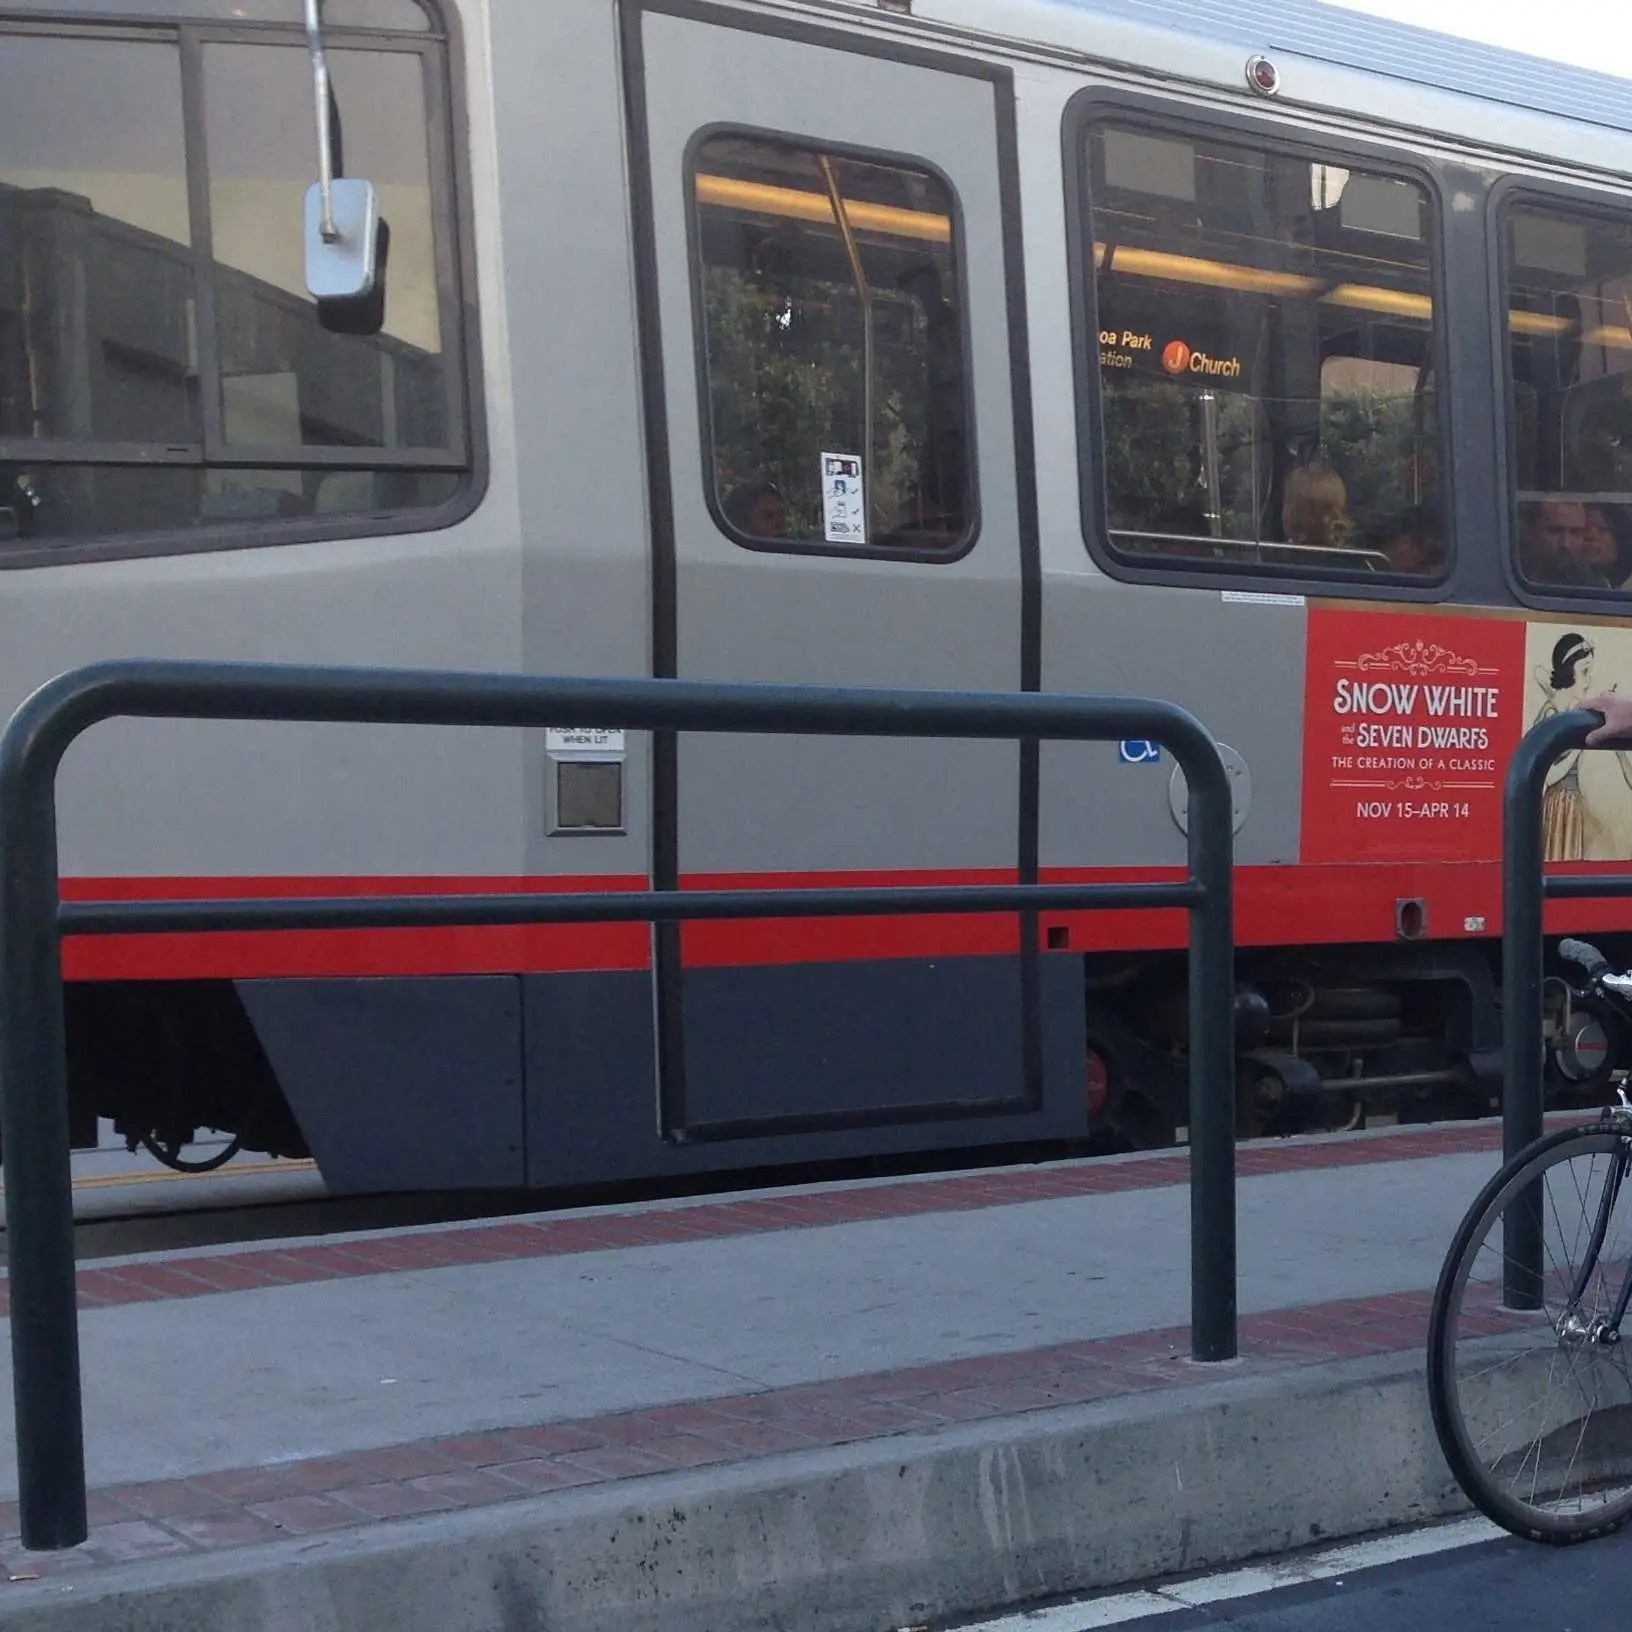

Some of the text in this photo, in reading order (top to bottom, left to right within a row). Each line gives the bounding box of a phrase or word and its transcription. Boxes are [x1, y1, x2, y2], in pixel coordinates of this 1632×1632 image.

[1121, 331, 1152, 350] Park
[1190, 352, 1240, 376] Church
[1334, 678, 1499, 718] SNOW WHITE
[1357, 722, 1489, 749] SEVEN DWARFS
[1332, 756, 1496, 771] THE CREATION OF A CLASSIC
[1357, 802, 1392, 818] NOV
[1454, 803, 1470, 818] 14
